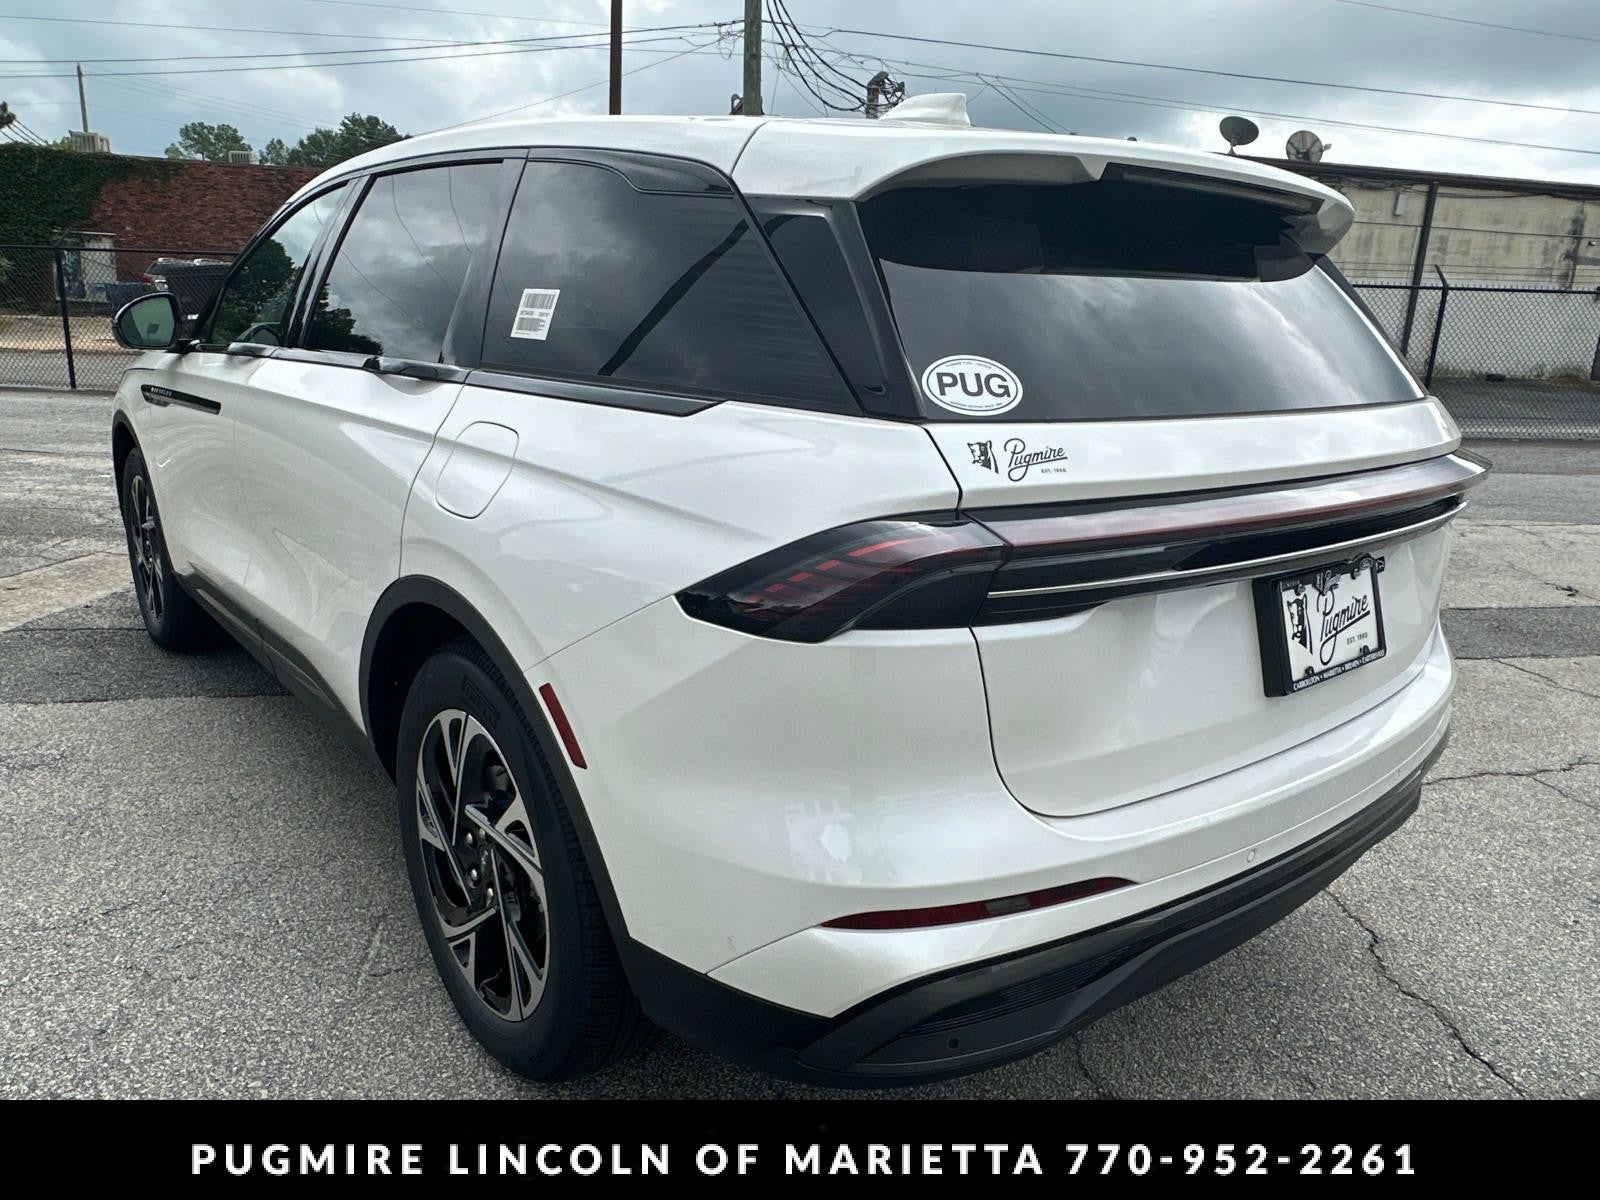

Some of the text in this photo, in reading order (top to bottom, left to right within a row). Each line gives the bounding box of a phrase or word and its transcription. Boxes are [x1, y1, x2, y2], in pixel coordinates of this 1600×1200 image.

[936, 372, 1011, 398] PUG
[1004, 438, 1068, 482] Pugmire
[1317, 587, 1370, 665] Pugmire
